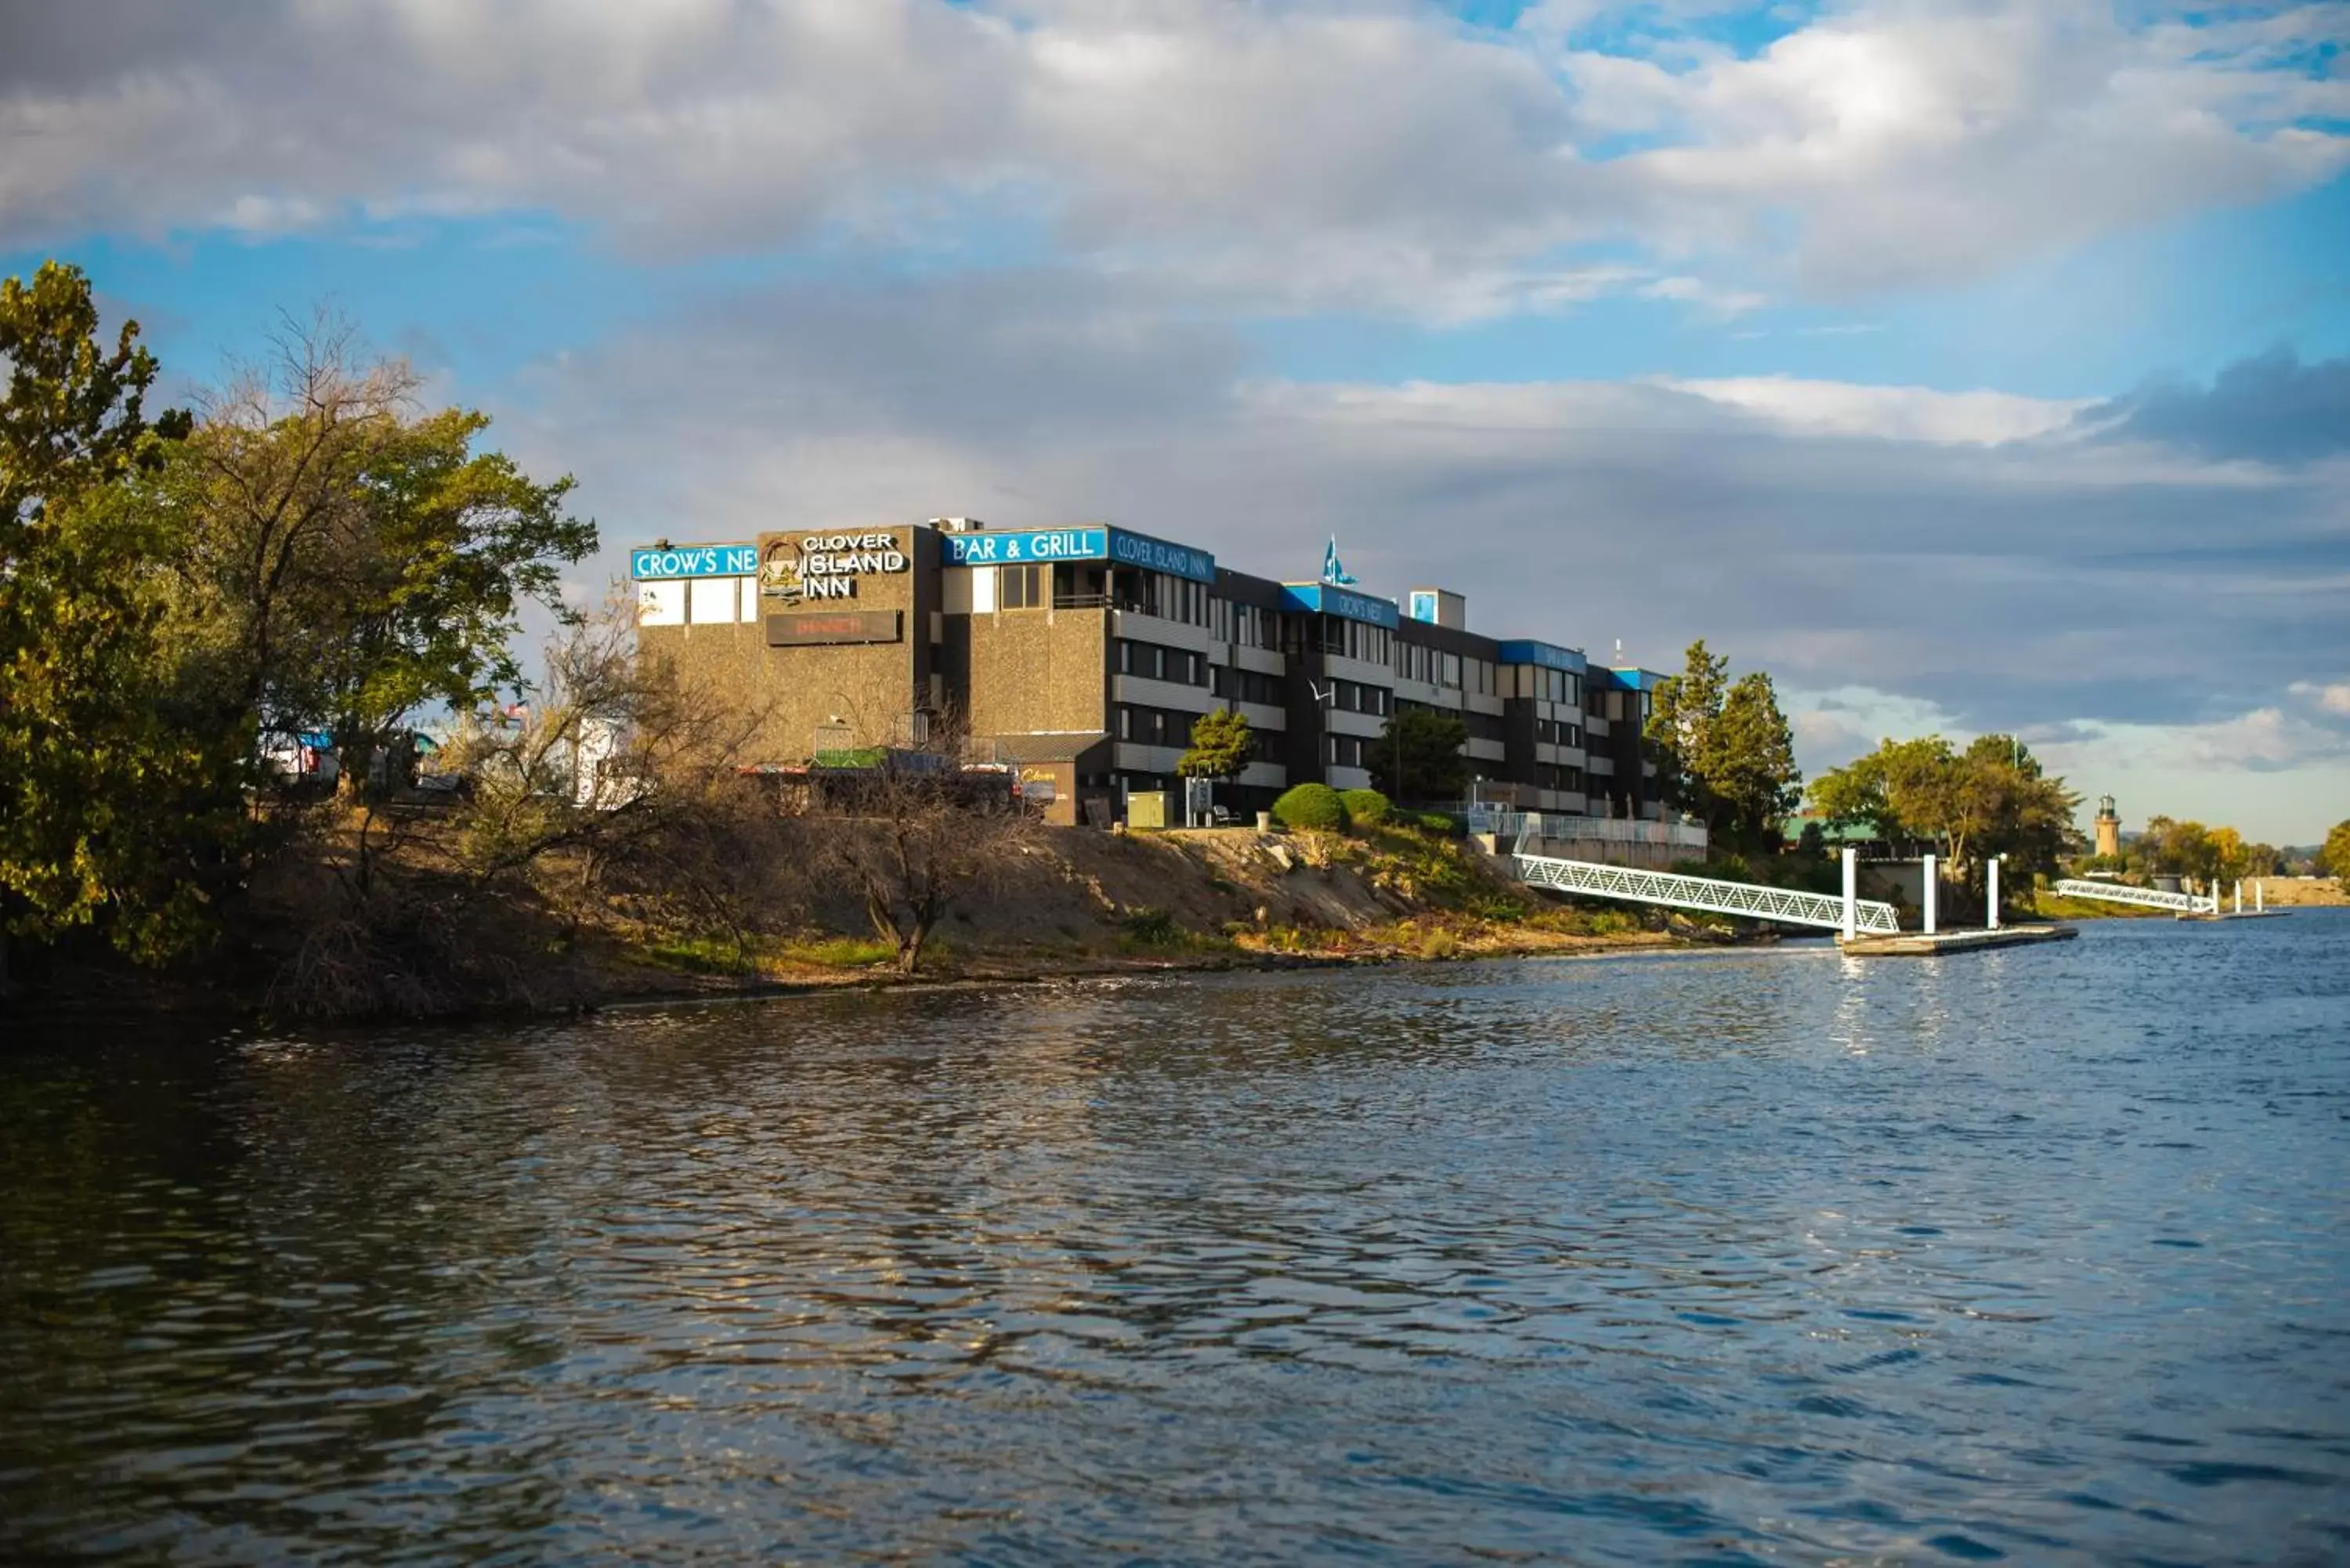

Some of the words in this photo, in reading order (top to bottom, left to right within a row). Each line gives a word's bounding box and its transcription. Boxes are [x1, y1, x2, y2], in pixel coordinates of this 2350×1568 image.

[803, 533, 891, 550] CLOVER
[953, 538, 996, 560] BAR
[1007, 540, 1021, 558] &
[1031, 533, 1094, 557] GRILL
[637, 548, 717, 576] CROW'S
[727, 549, 757, 572] NE
[803, 551, 903, 573] ISLAND
[1116, 536, 1152, 563] CLOVER
[1155, 546, 1186, 573] ISLAND
[1190, 554, 1206, 576] INN
[803, 576, 850, 598] INN
